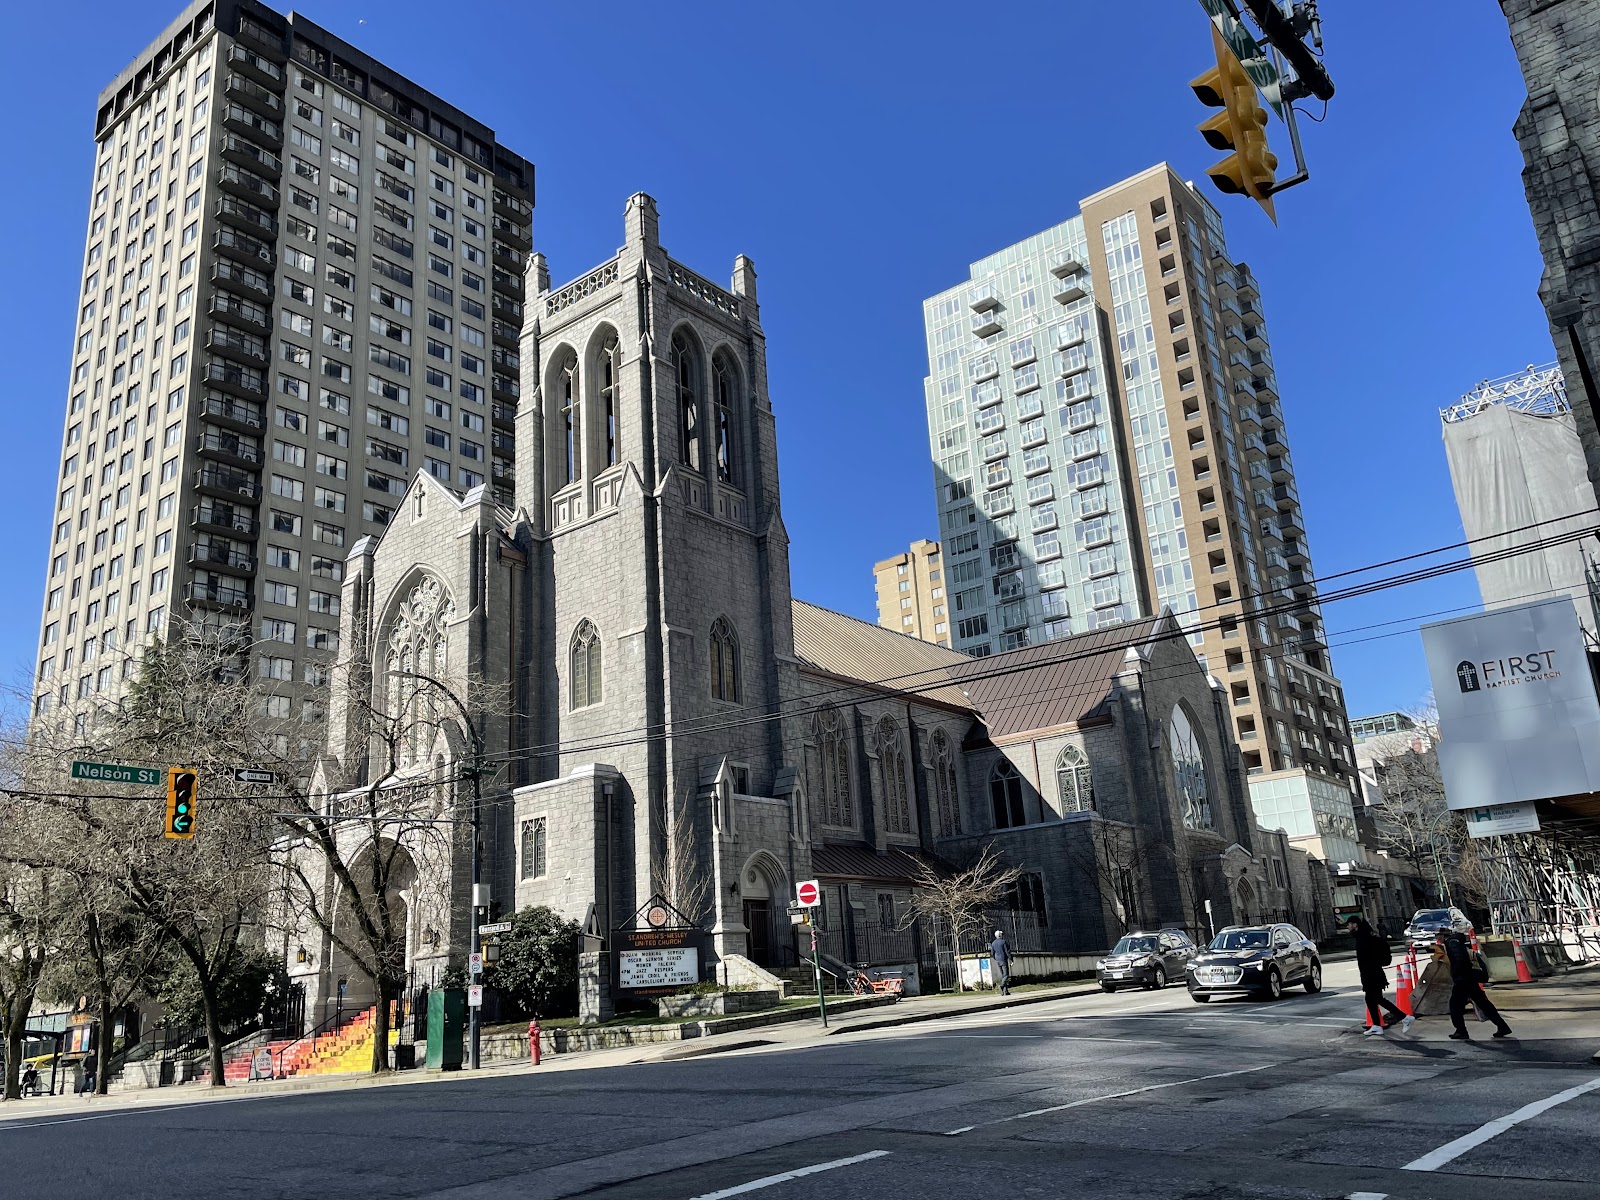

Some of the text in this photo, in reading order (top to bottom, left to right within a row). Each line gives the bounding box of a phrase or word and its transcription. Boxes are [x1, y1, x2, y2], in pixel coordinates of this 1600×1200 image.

[1482, 650, 1555, 680] FIRST
[1486, 670, 1561, 689] BAPTIST CHURCH
[78, 764, 155, 783] Nelson St
